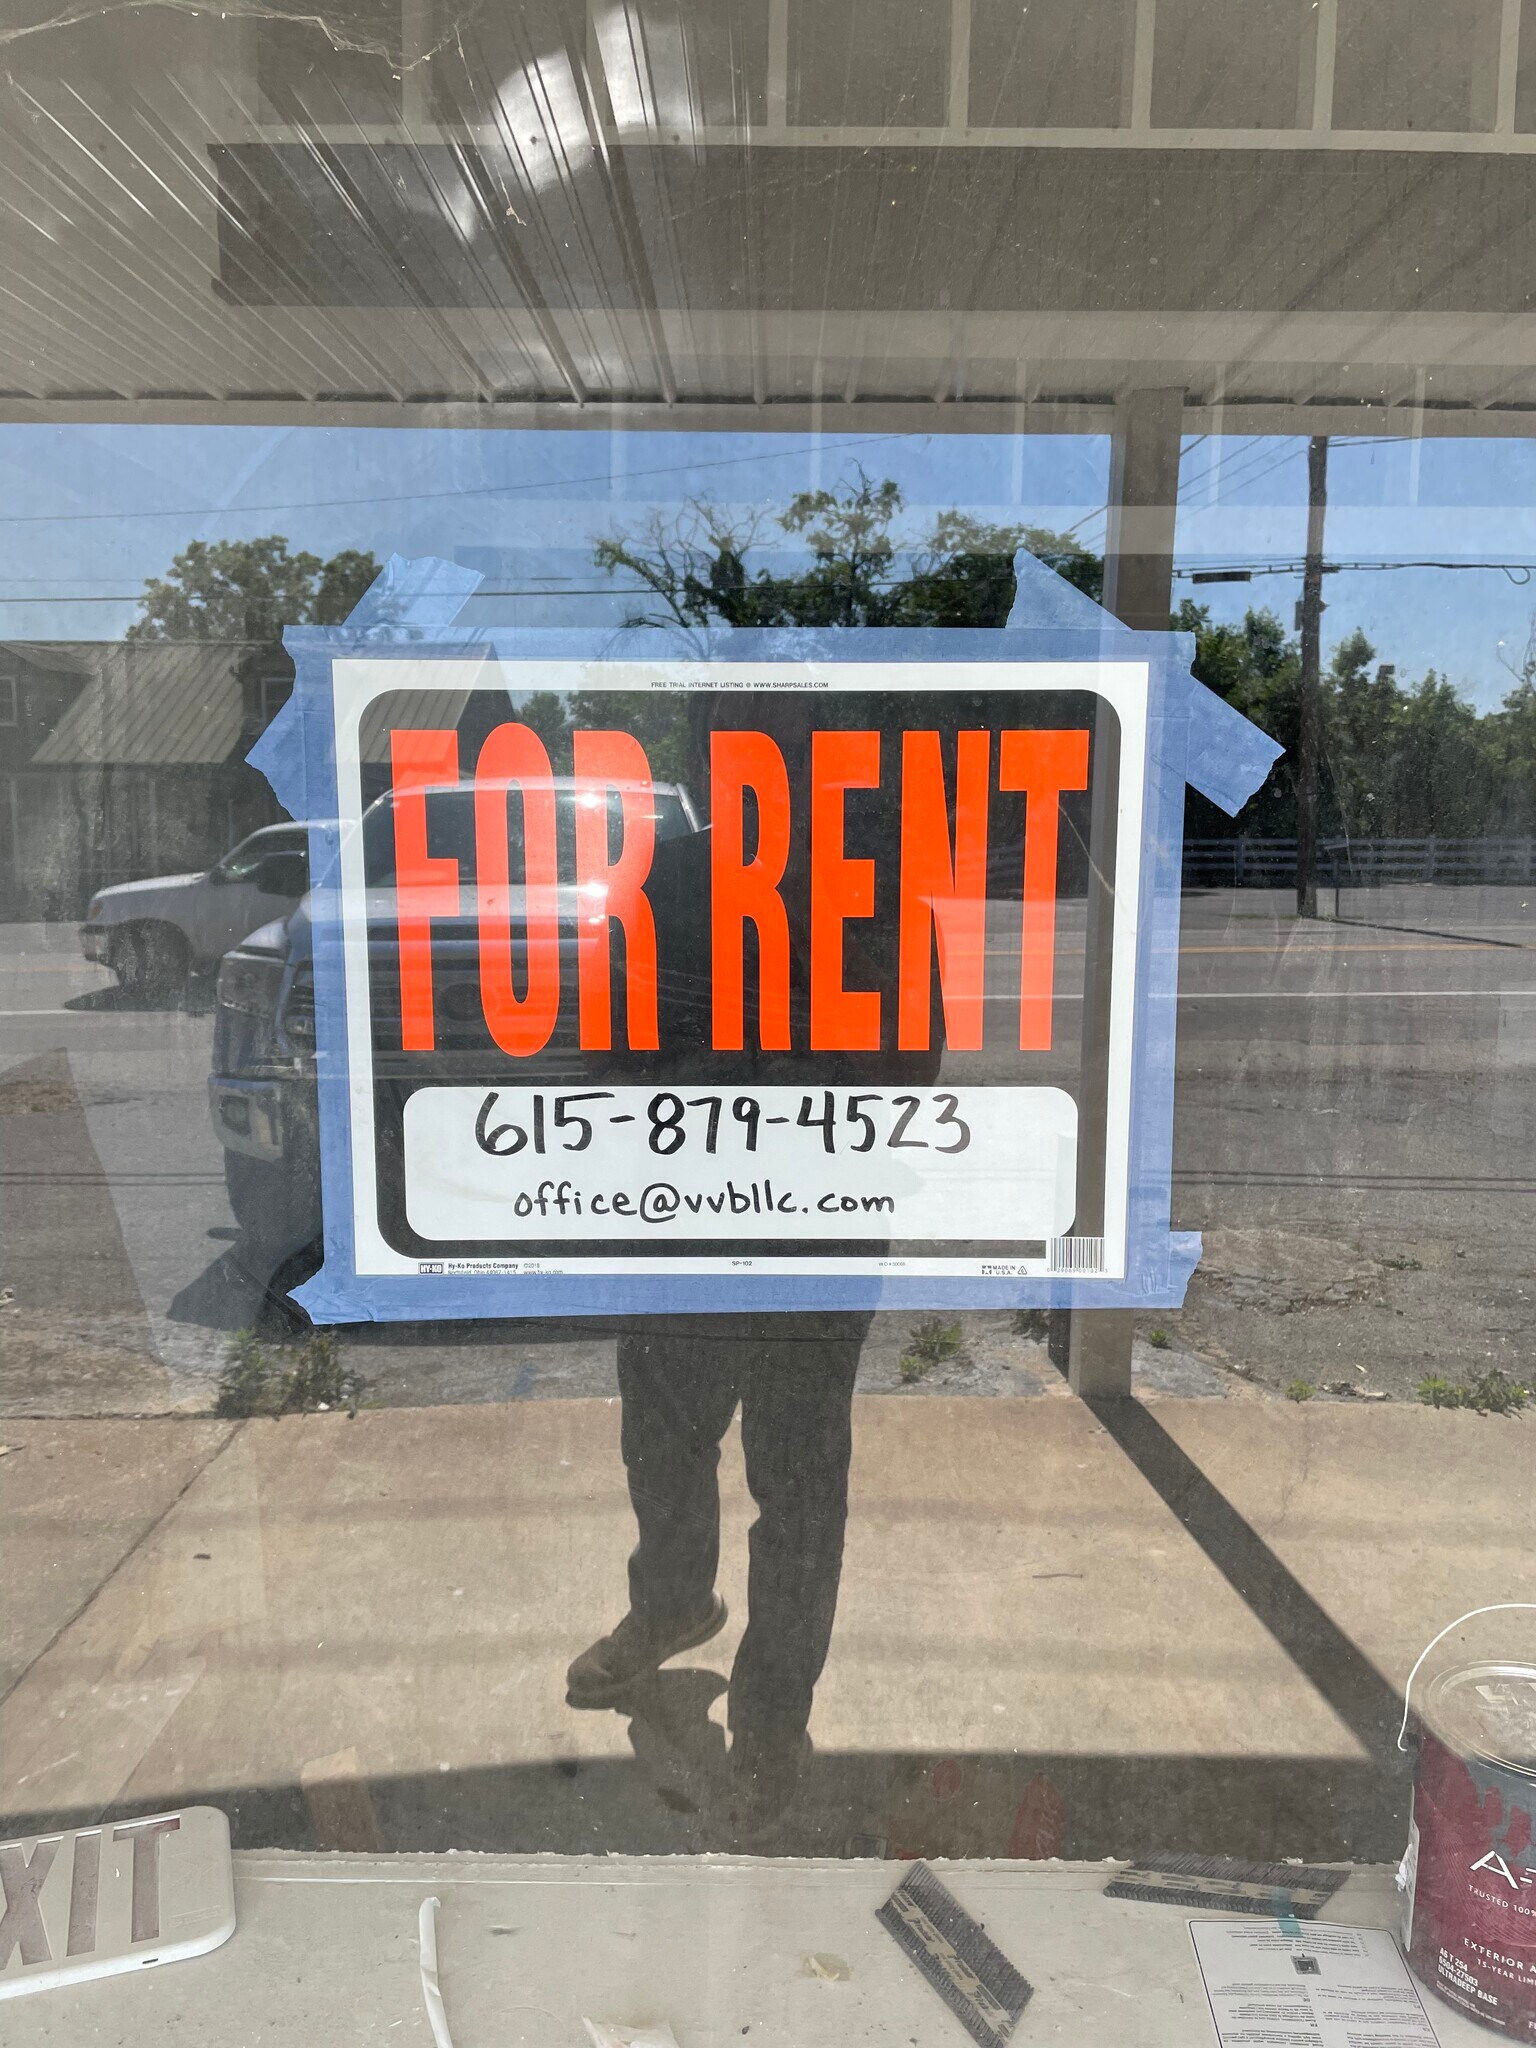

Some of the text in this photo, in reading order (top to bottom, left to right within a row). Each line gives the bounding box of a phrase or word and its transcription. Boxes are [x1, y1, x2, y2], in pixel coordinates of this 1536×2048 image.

[390, 722, 1090, 1057] FOR RENT
[475, 1090, 971, 1156] 615-879-4523
[1469, 1850, 1536, 1889] A-
[1469, 1884, 1509, 1908] TRUSTED
[1449, 1953, 1454, 1963] T
[1464, 1937, 1524, 1970] EXTERIOR
[1477, 1958, 1514, 1980] 15-YEAR
[1438, 1964, 1476, 1994] ULTRADEEP
[1477, 1989, 1498, 2006] BASE
